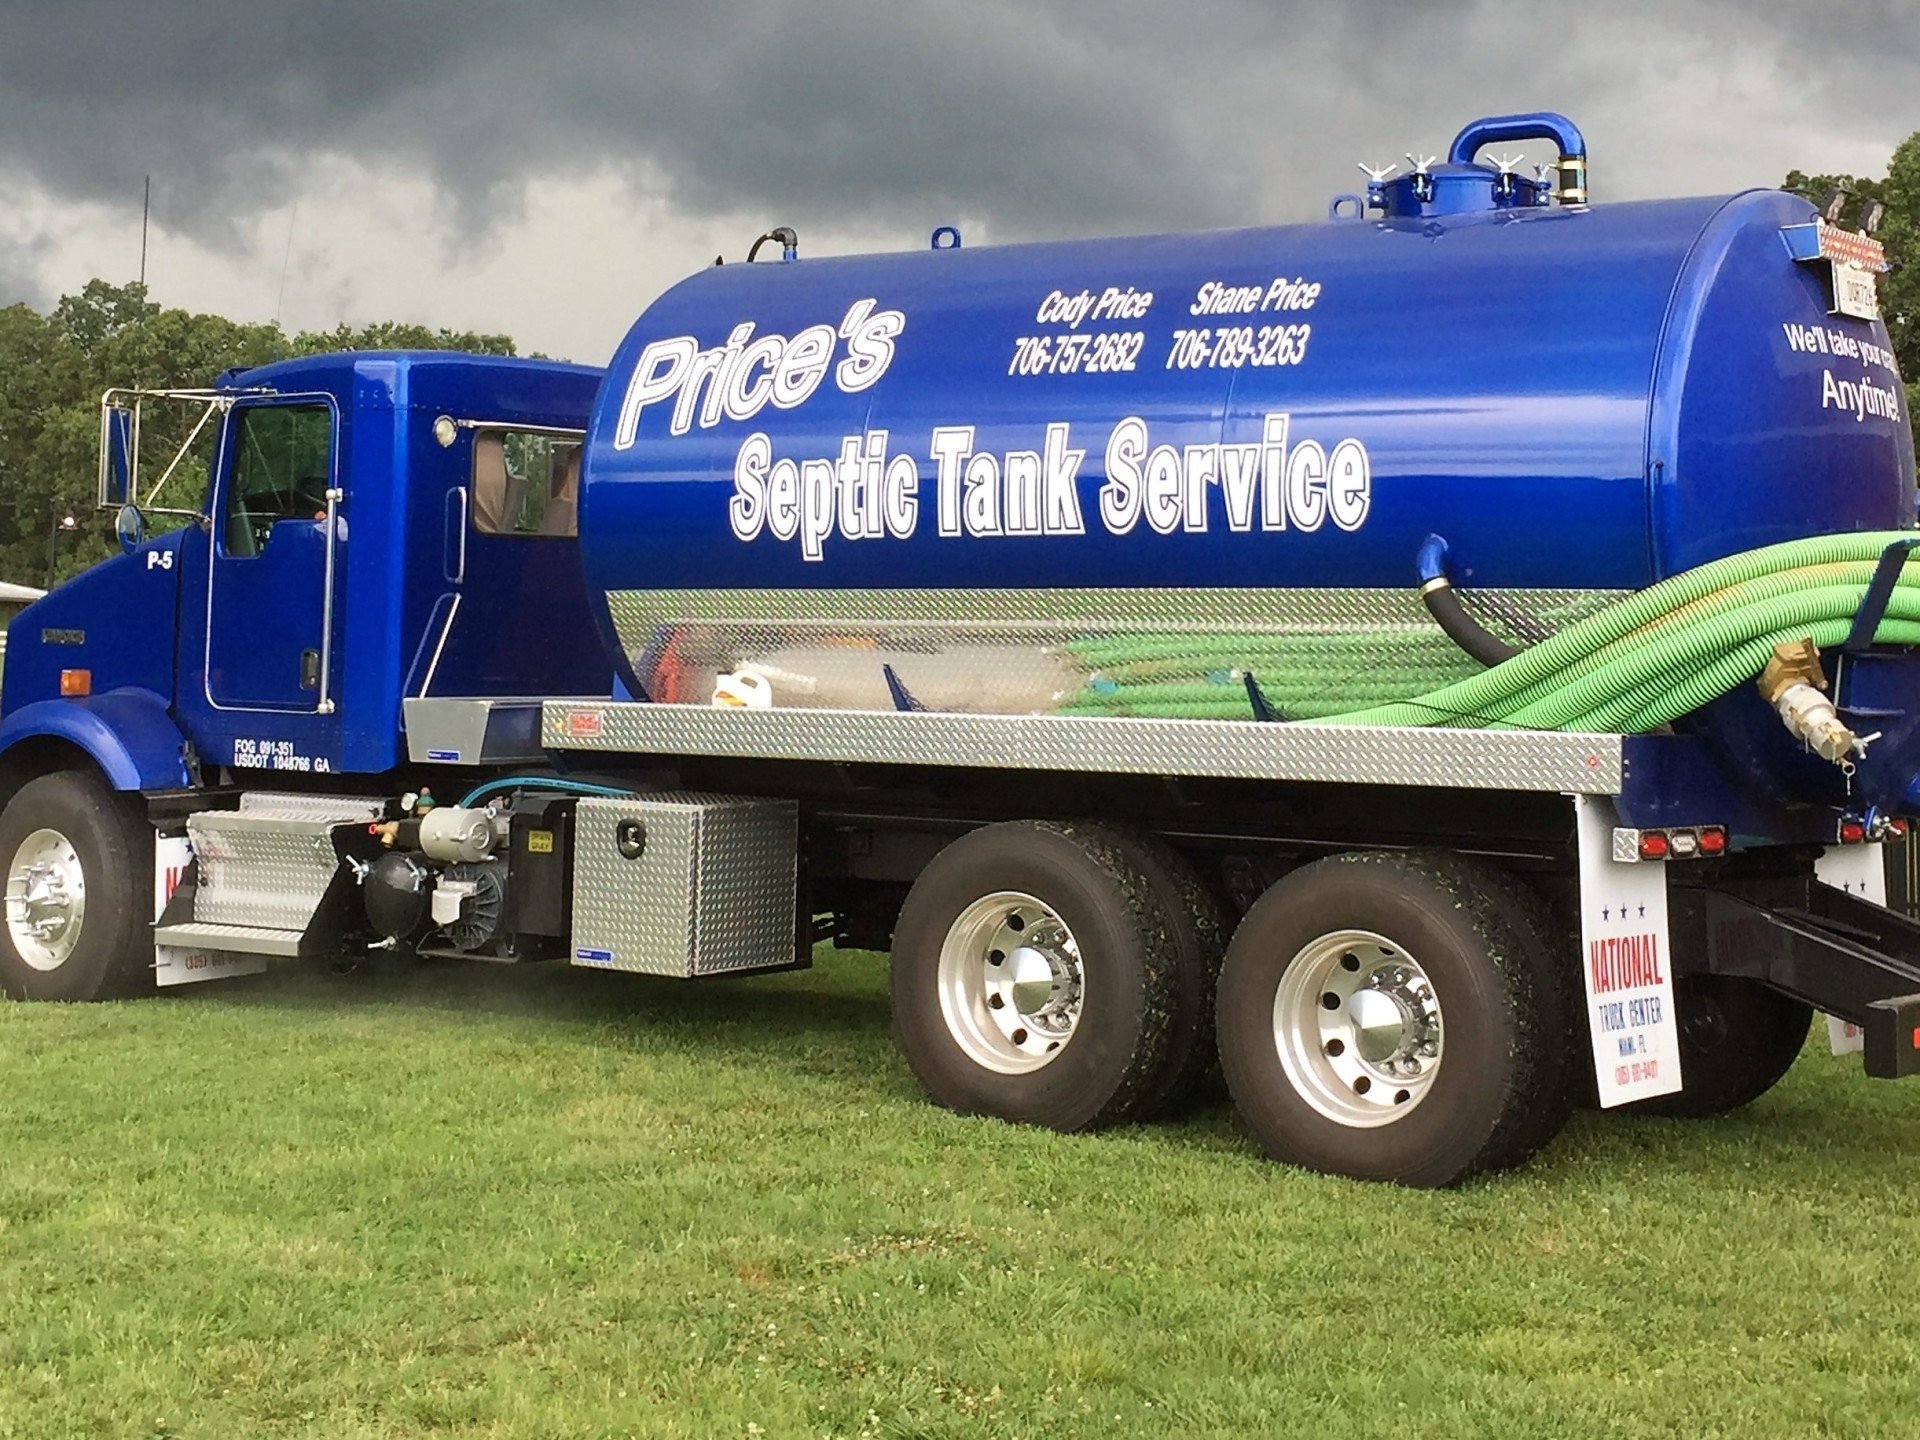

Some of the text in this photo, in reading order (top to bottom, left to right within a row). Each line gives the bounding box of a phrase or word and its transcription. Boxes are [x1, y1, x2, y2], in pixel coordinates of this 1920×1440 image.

[1036, 286, 1153, 329] Cody Price
[1189, 277, 1321, 316] Shane Price
[1008, 331, 1145, 376] 706-757-2682
[1166, 324, 1311, 370] 706-789-3263
[1783, 323, 1828, 353] We'll
[1827, 328, 1859, 359] take
[1857, 340, 1881, 367] your
[613, 298, 906, 450] Price's
[1822, 369, 1901, 422] Anytime!
[729, 412, 1371, 562] Septic Tank Service
[147, 550, 173, 570] P-5
[234, 739, 256, 753] FOG
[234, 752, 269, 768] USDOT
[314, 757, 330, 773] GA
[1590, 933, 1663, 995] NATIONAL
[1599, 996, 1663, 1032] TRUCK CENTER
